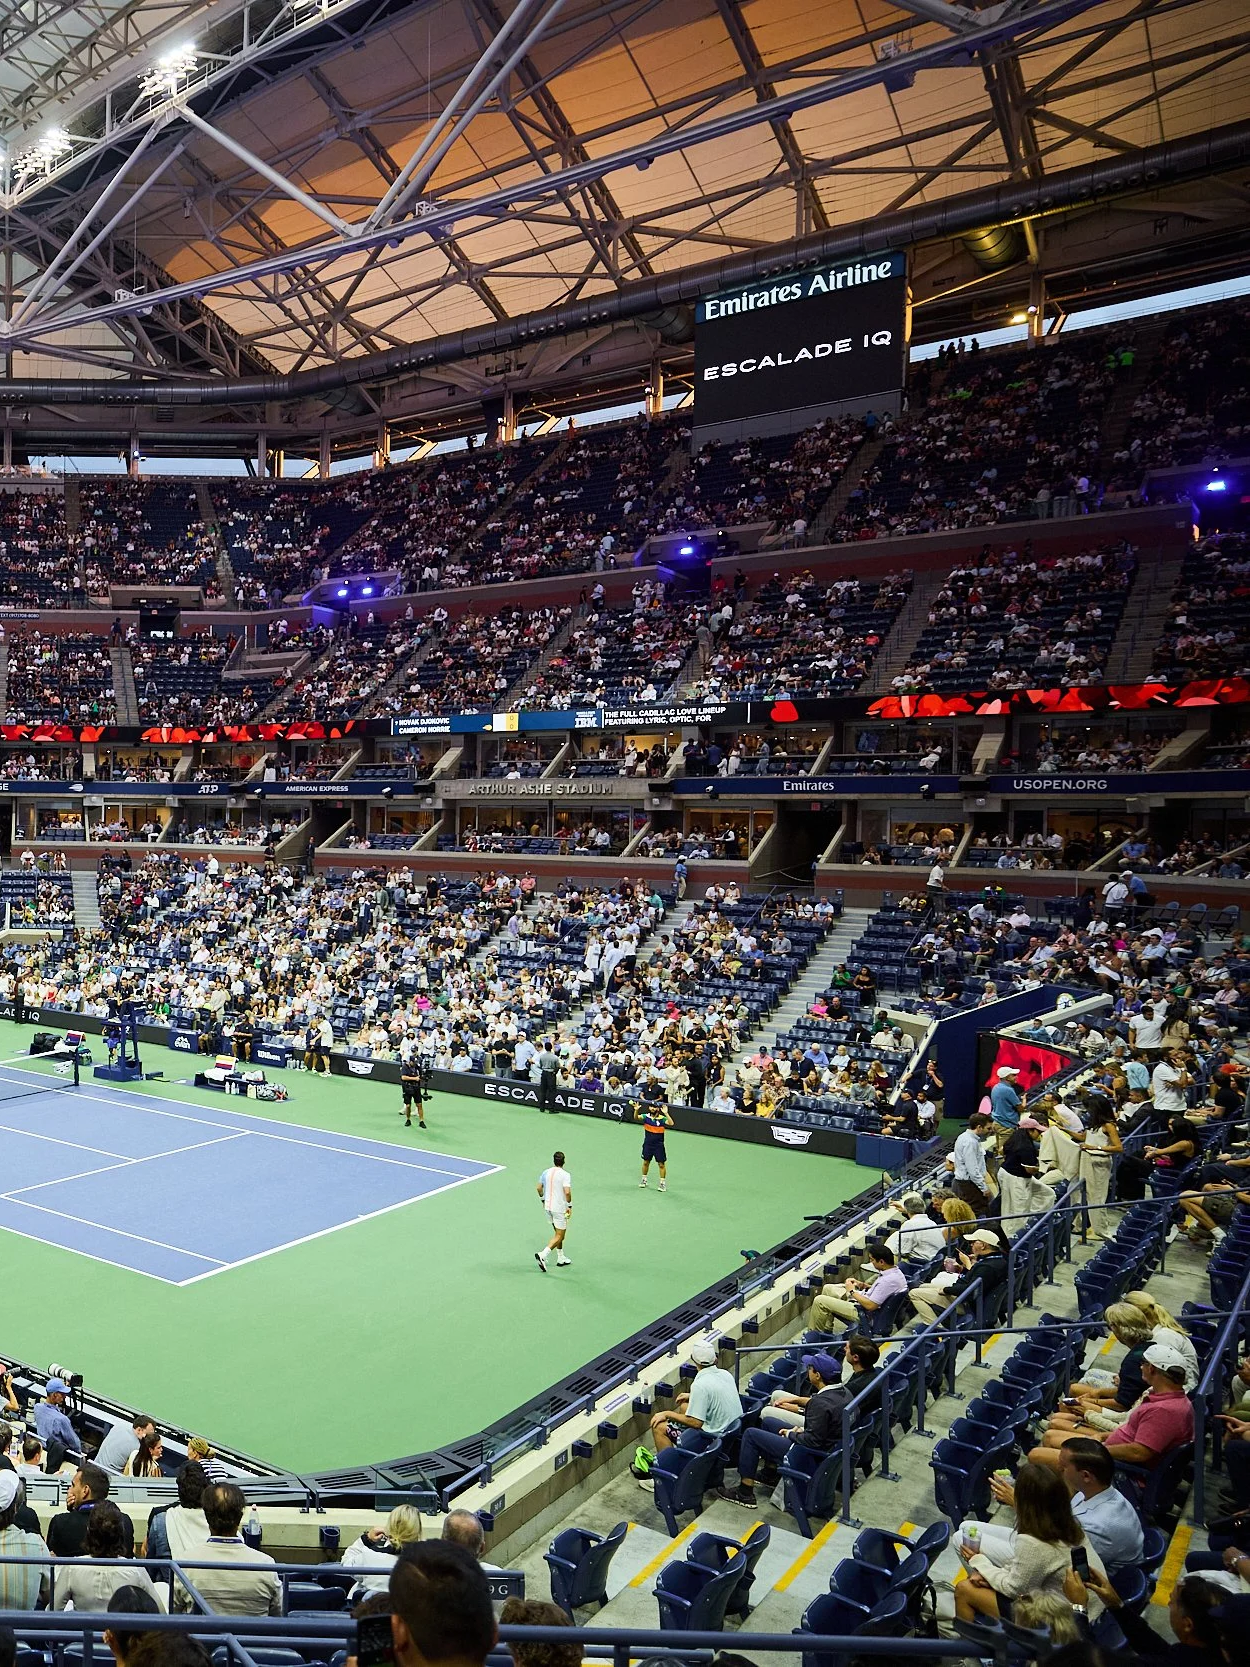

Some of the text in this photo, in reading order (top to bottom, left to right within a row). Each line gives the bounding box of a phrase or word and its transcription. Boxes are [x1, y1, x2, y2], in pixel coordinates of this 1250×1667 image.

[705, 260, 892, 320] Emirates Airline
[703, 330, 892, 381] ESCALADE IQ
[605, 706, 726, 719] THE FULL CADILLAC LOVE LINEUP
[398, 718, 419, 726] NOVAK
[420, 717, 450, 725] DJOKOVIC
[575, 717, 598, 729] IBM
[605, 714, 712, 726] FEATURING LYRIC, OPTIC, FOR
[399, 725, 450, 735] CAMERON NORRIE
[198, 784, 219, 794] ATP
[468, 783, 613, 795] ARTHUR ASHE STADIUM
[783, 780, 835, 791] Emirates
[1013, 779, 1108, 790] USOPEN.ORG
[28, 1011, 40, 1022] IQ
[257, 1050, 281, 1061] Wilson
[484, 1083, 625, 1117] ESCAADE IQ
[498, 1584, 509, 1595] G
